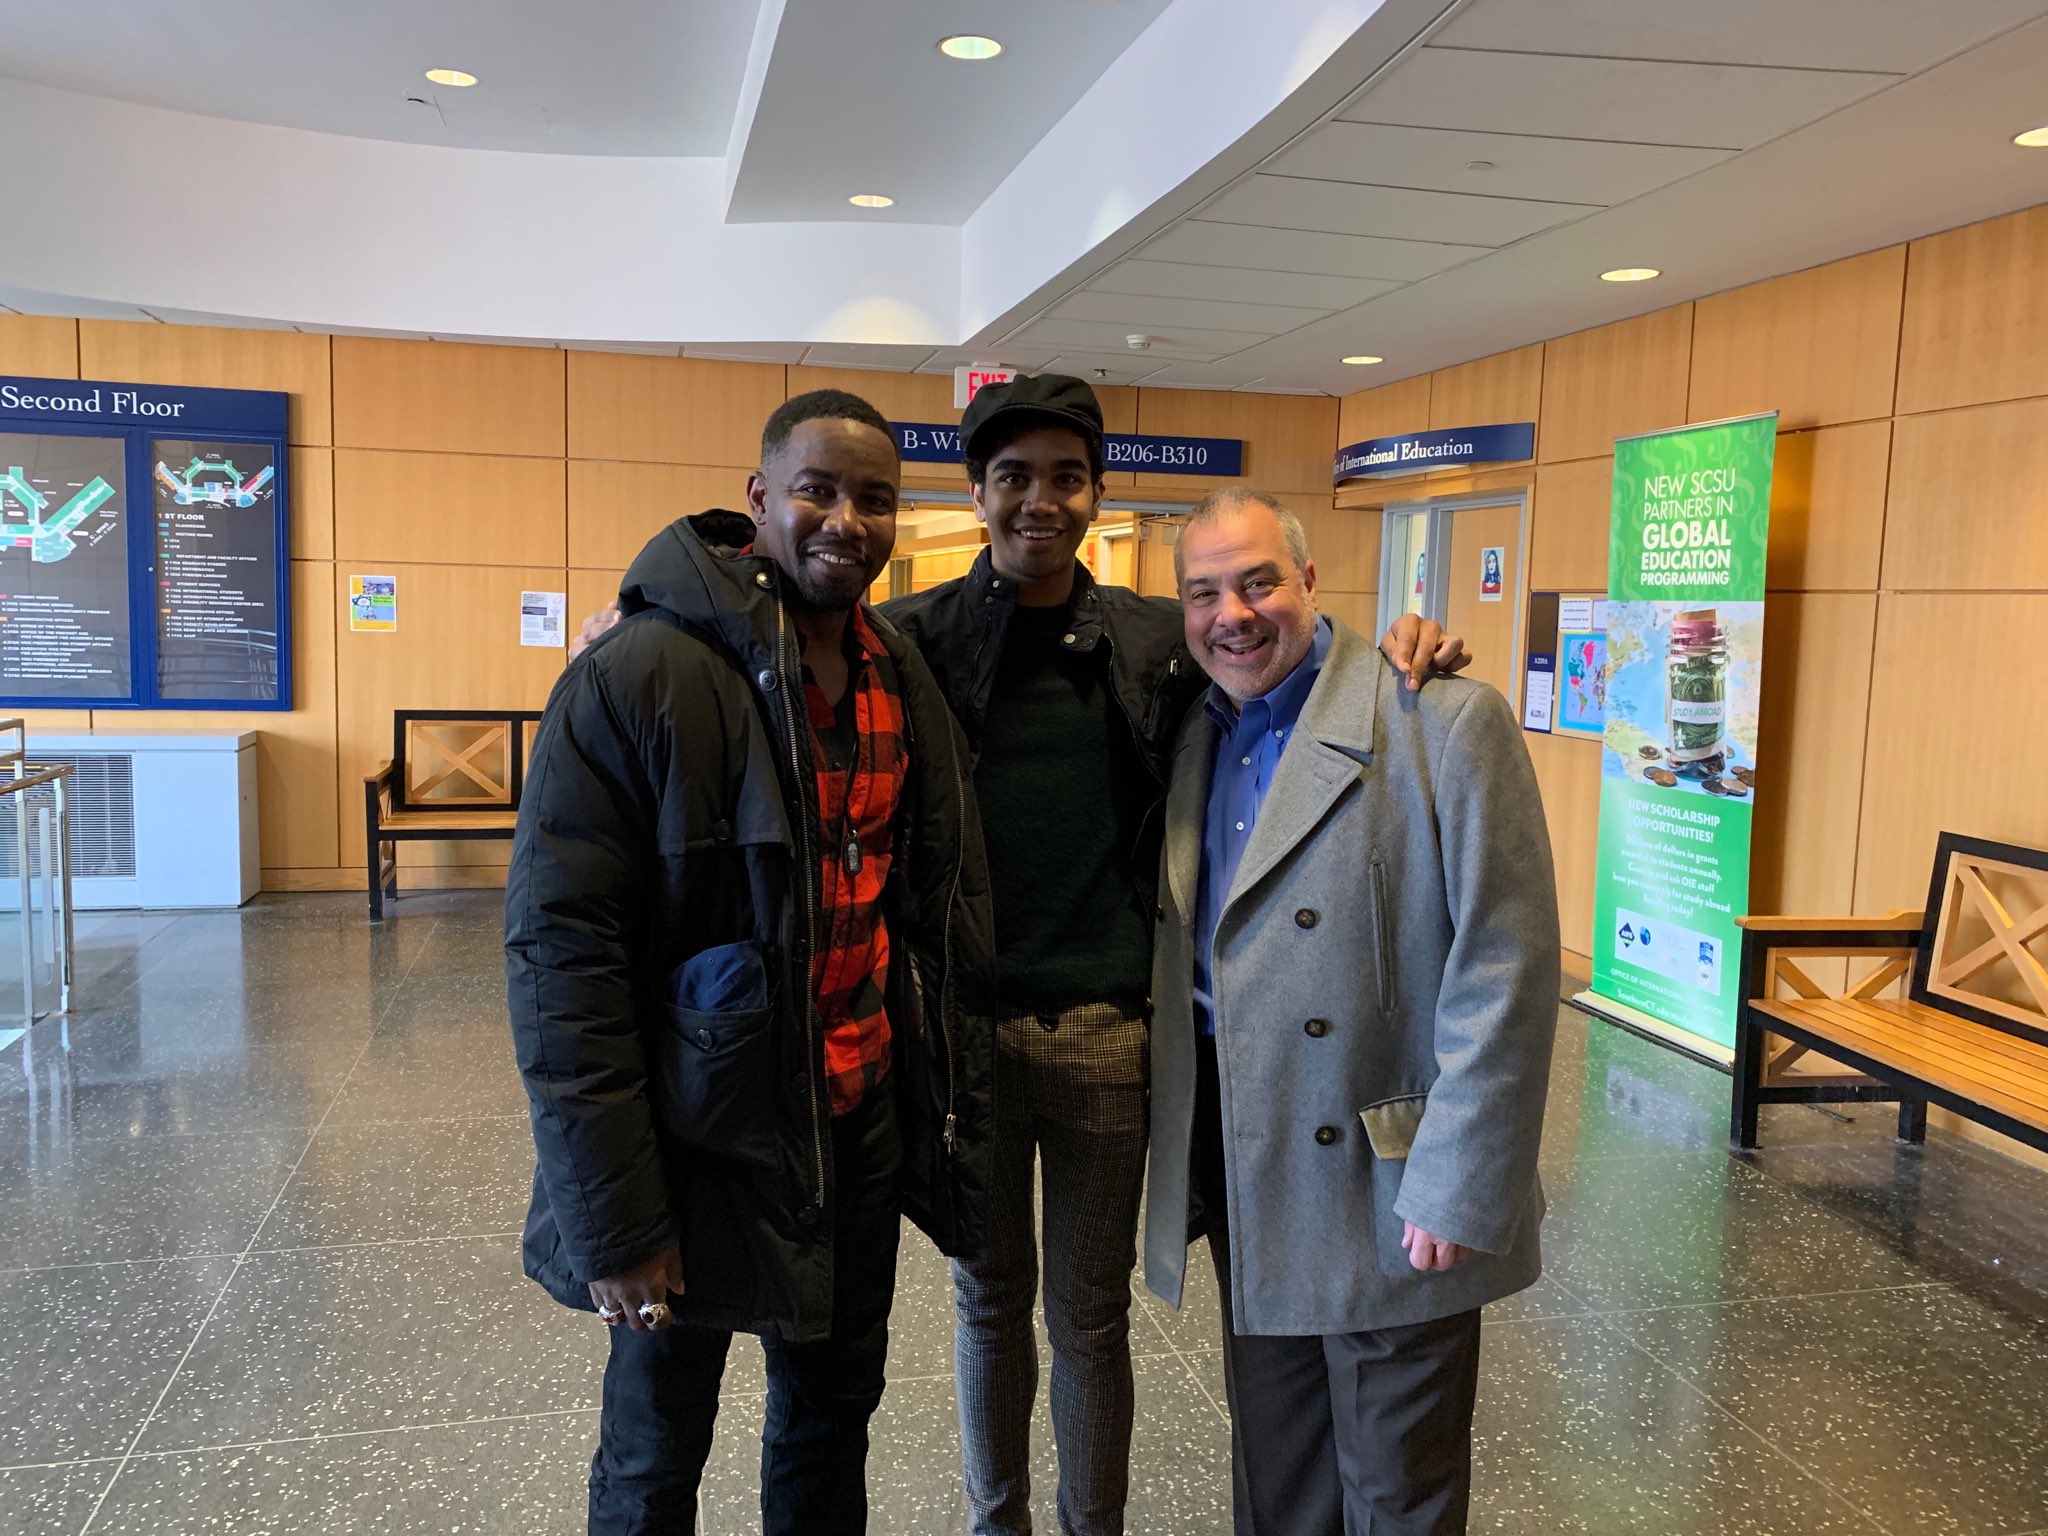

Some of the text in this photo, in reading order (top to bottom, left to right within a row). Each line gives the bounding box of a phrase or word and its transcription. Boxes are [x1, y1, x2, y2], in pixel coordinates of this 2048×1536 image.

[0, 386, 184, 417] Second Floor
[1108, 442, 1208, 466] B206-B310
[1346, 444, 1398, 470] International
[1401, 438, 1473, 460] Education
[1645, 468, 1735, 499] NEW SCSU
[1644, 495, 1733, 521] PARTNERS IN
[1643, 518, 1732, 550] GLOBAL
[1641, 549, 1731, 570] EDUCATION
[1641, 571, 1730, 585] PROGRAMMING
[1673, 706, 1721, 717] STUDY ABROAD
[1628, 800, 1720, 828] NEW SCHOLARSHIP
[1633, 815, 1714, 843] OPPORTUNITIES!
[1654, 842, 1662, 850] of
[1662, 843, 1686, 858] dollars
[1687, 849, 1694, 859] in
[1696, 854, 1718, 865] grants
[1658, 856, 1688, 872] students
[1689, 866, 1722, 883] annually.
[1682, 876, 1697, 889] OIE
[1698, 882, 1715, 893] staff
[1671, 904, 1693, 918] today!
[1683, 891, 1703, 908] study
[1705, 899, 1730, 913] abroad
[1610, 968, 1629, 981] OFFICE
[1630, 975, 1638, 984] OF
